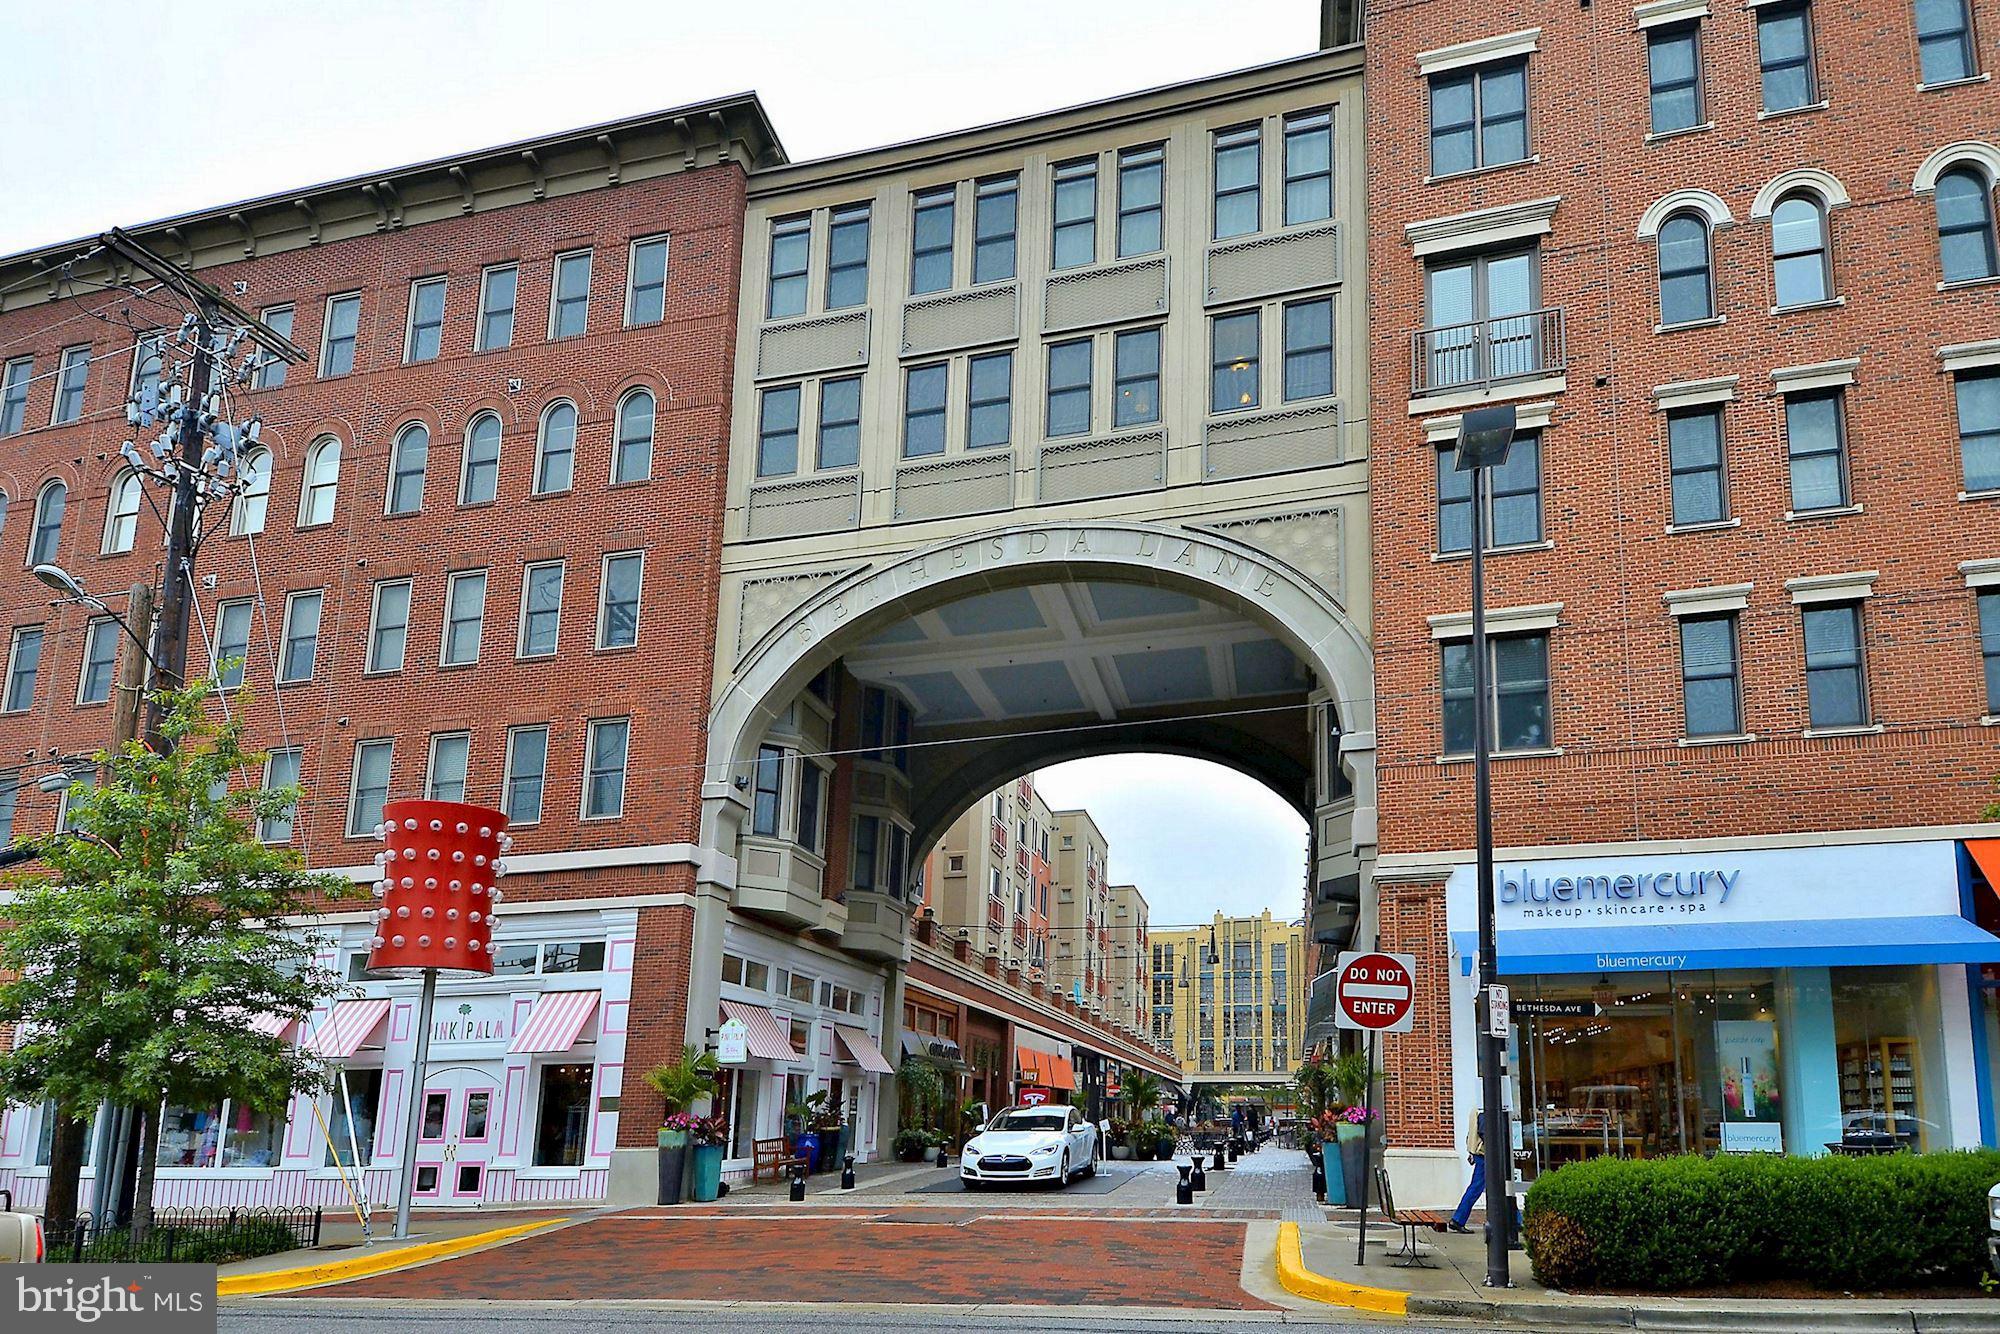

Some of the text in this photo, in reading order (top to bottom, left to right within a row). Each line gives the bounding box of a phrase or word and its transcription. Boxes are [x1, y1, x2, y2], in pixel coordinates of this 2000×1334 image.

[796, 529, 1280, 645] BETHESDA LANE
[1500, 868, 1741, 904] bluemercury
[1523, 903, 1707, 918] makeup skincare spa
[1596, 953, 1687, 969] bluemercury
[1350, 968, 1403, 981] DO NOT
[1353, 1001, 1395, 1015] ENTER
[1516, 1004, 1582, 1013] BETHESDA AVE
[430, 1020, 503, 1041] INK PALM
[1727, 1134, 1777, 1143] bluemercury
